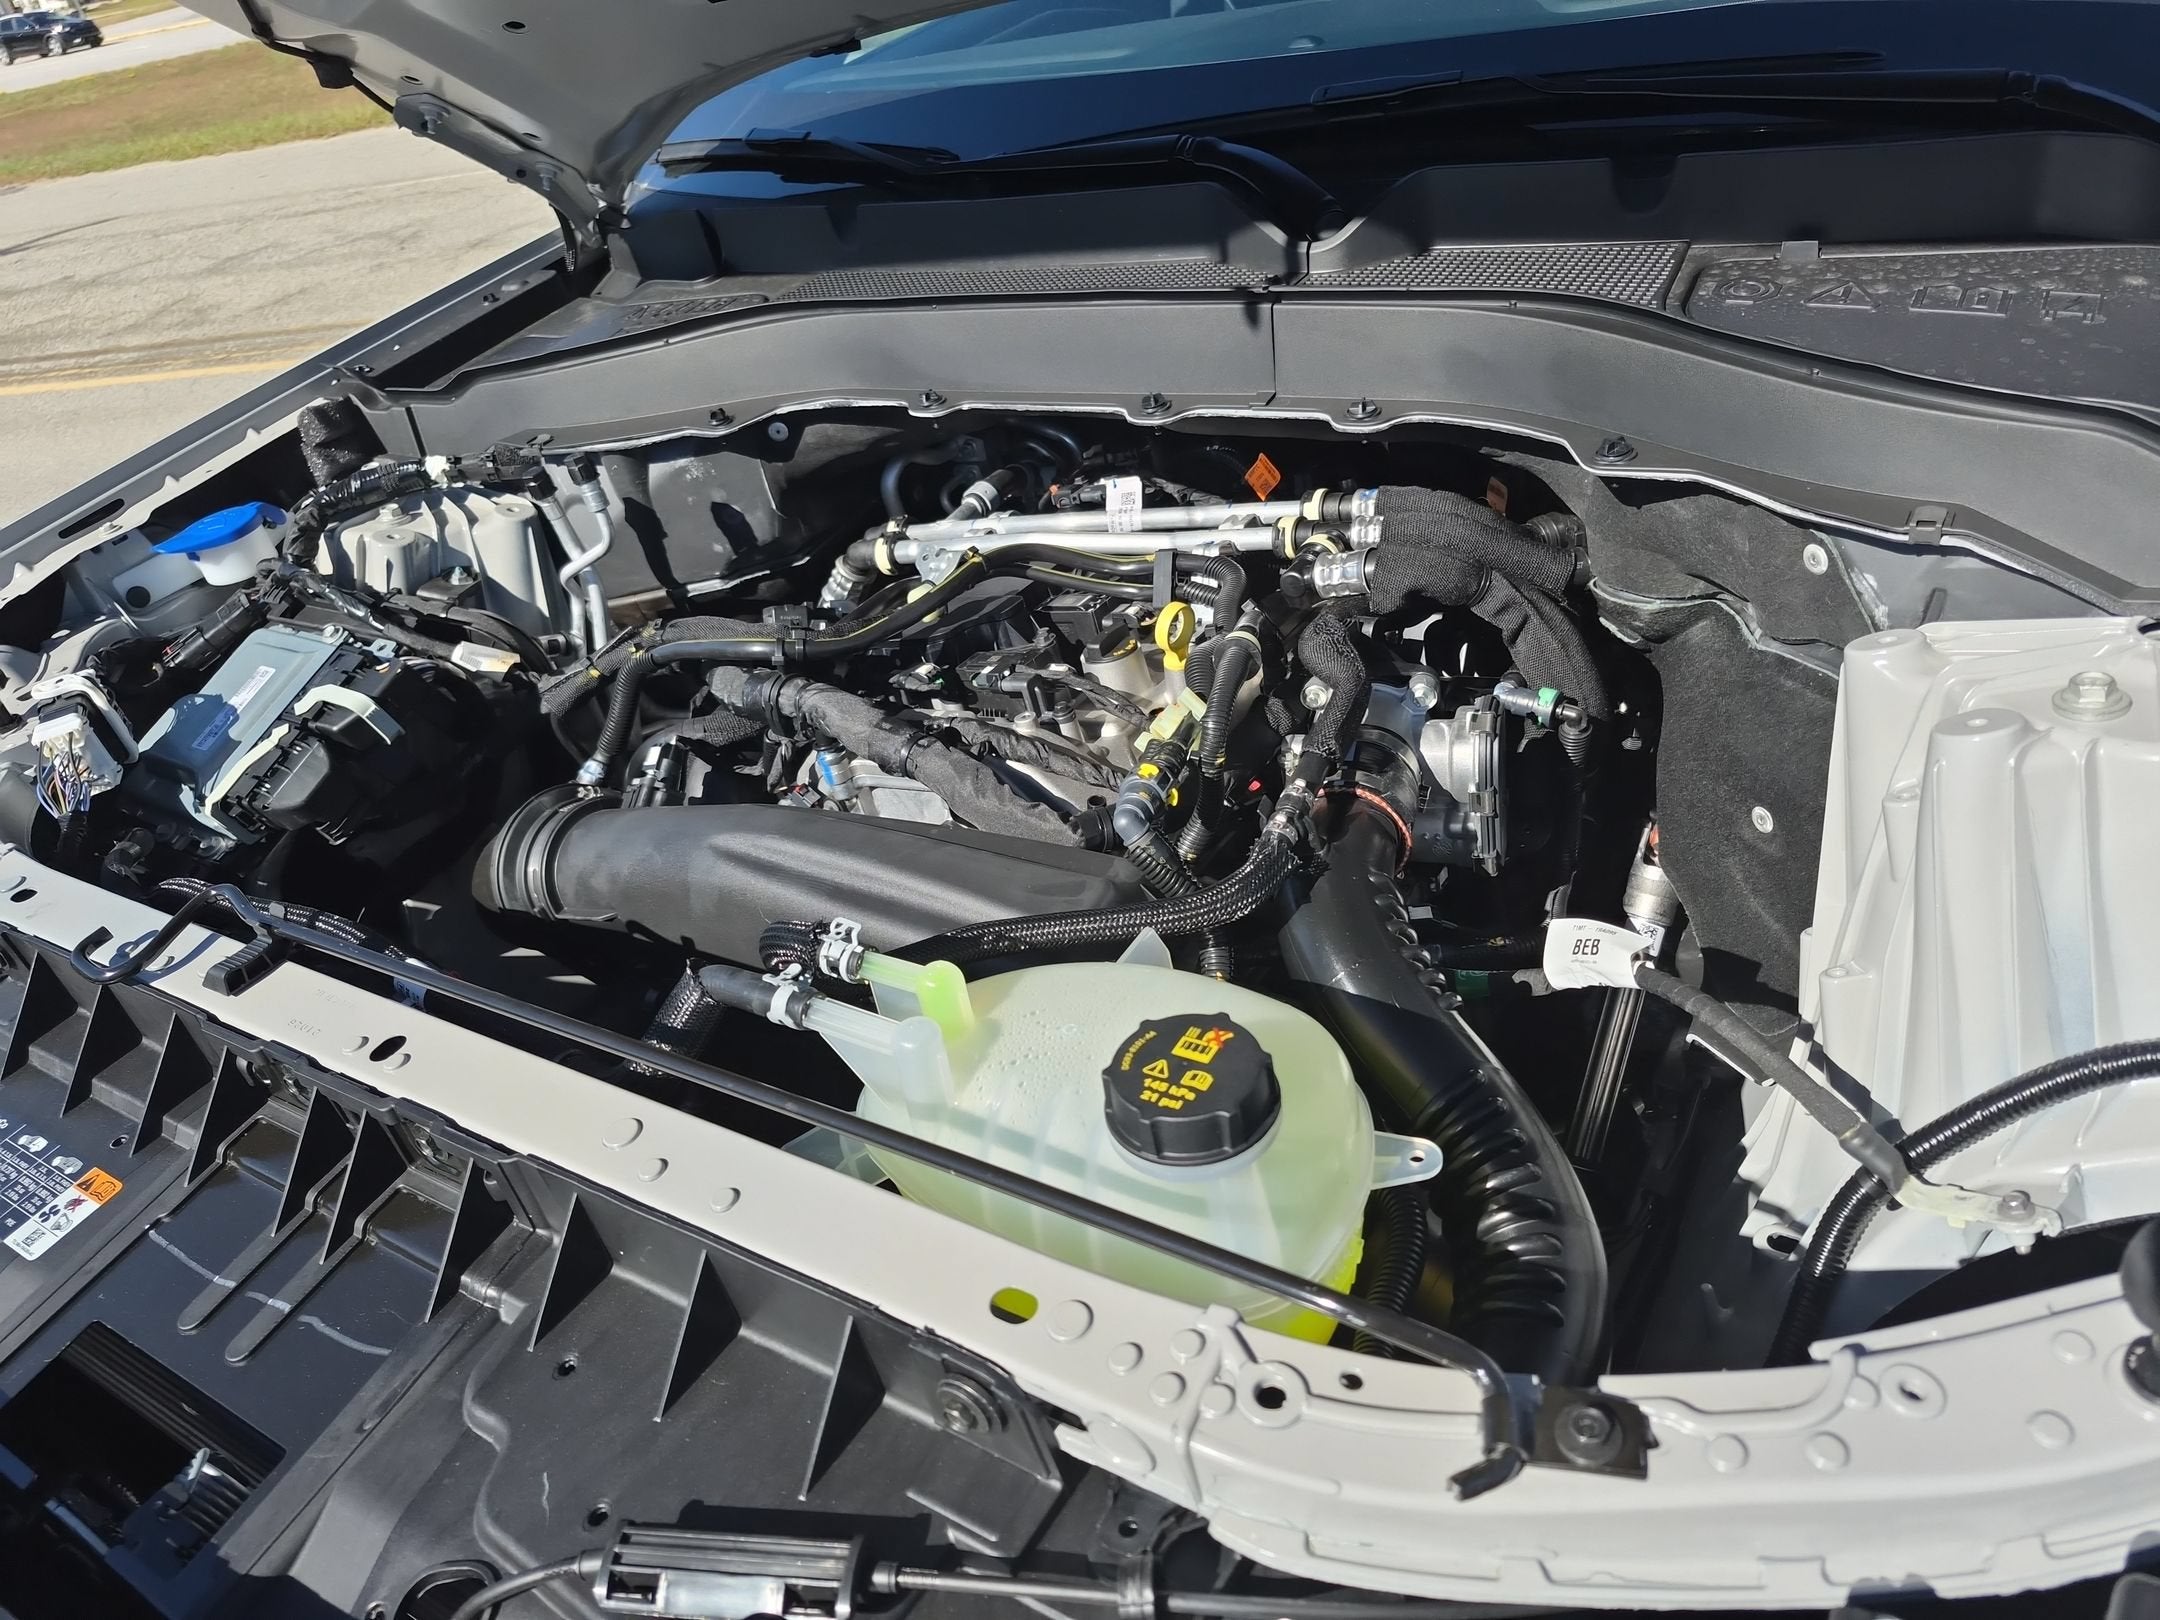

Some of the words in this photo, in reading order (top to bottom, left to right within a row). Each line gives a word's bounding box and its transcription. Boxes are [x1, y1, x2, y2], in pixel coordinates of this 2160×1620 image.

[1572, 938, 1601, 955] BEB
[1143, 1078, 1170, 1093] 145
[1168, 1085, 1197, 1101] kPa
[1139, 1090, 1160, 1103] 21
[1158, 1097, 1184, 1110] psi
